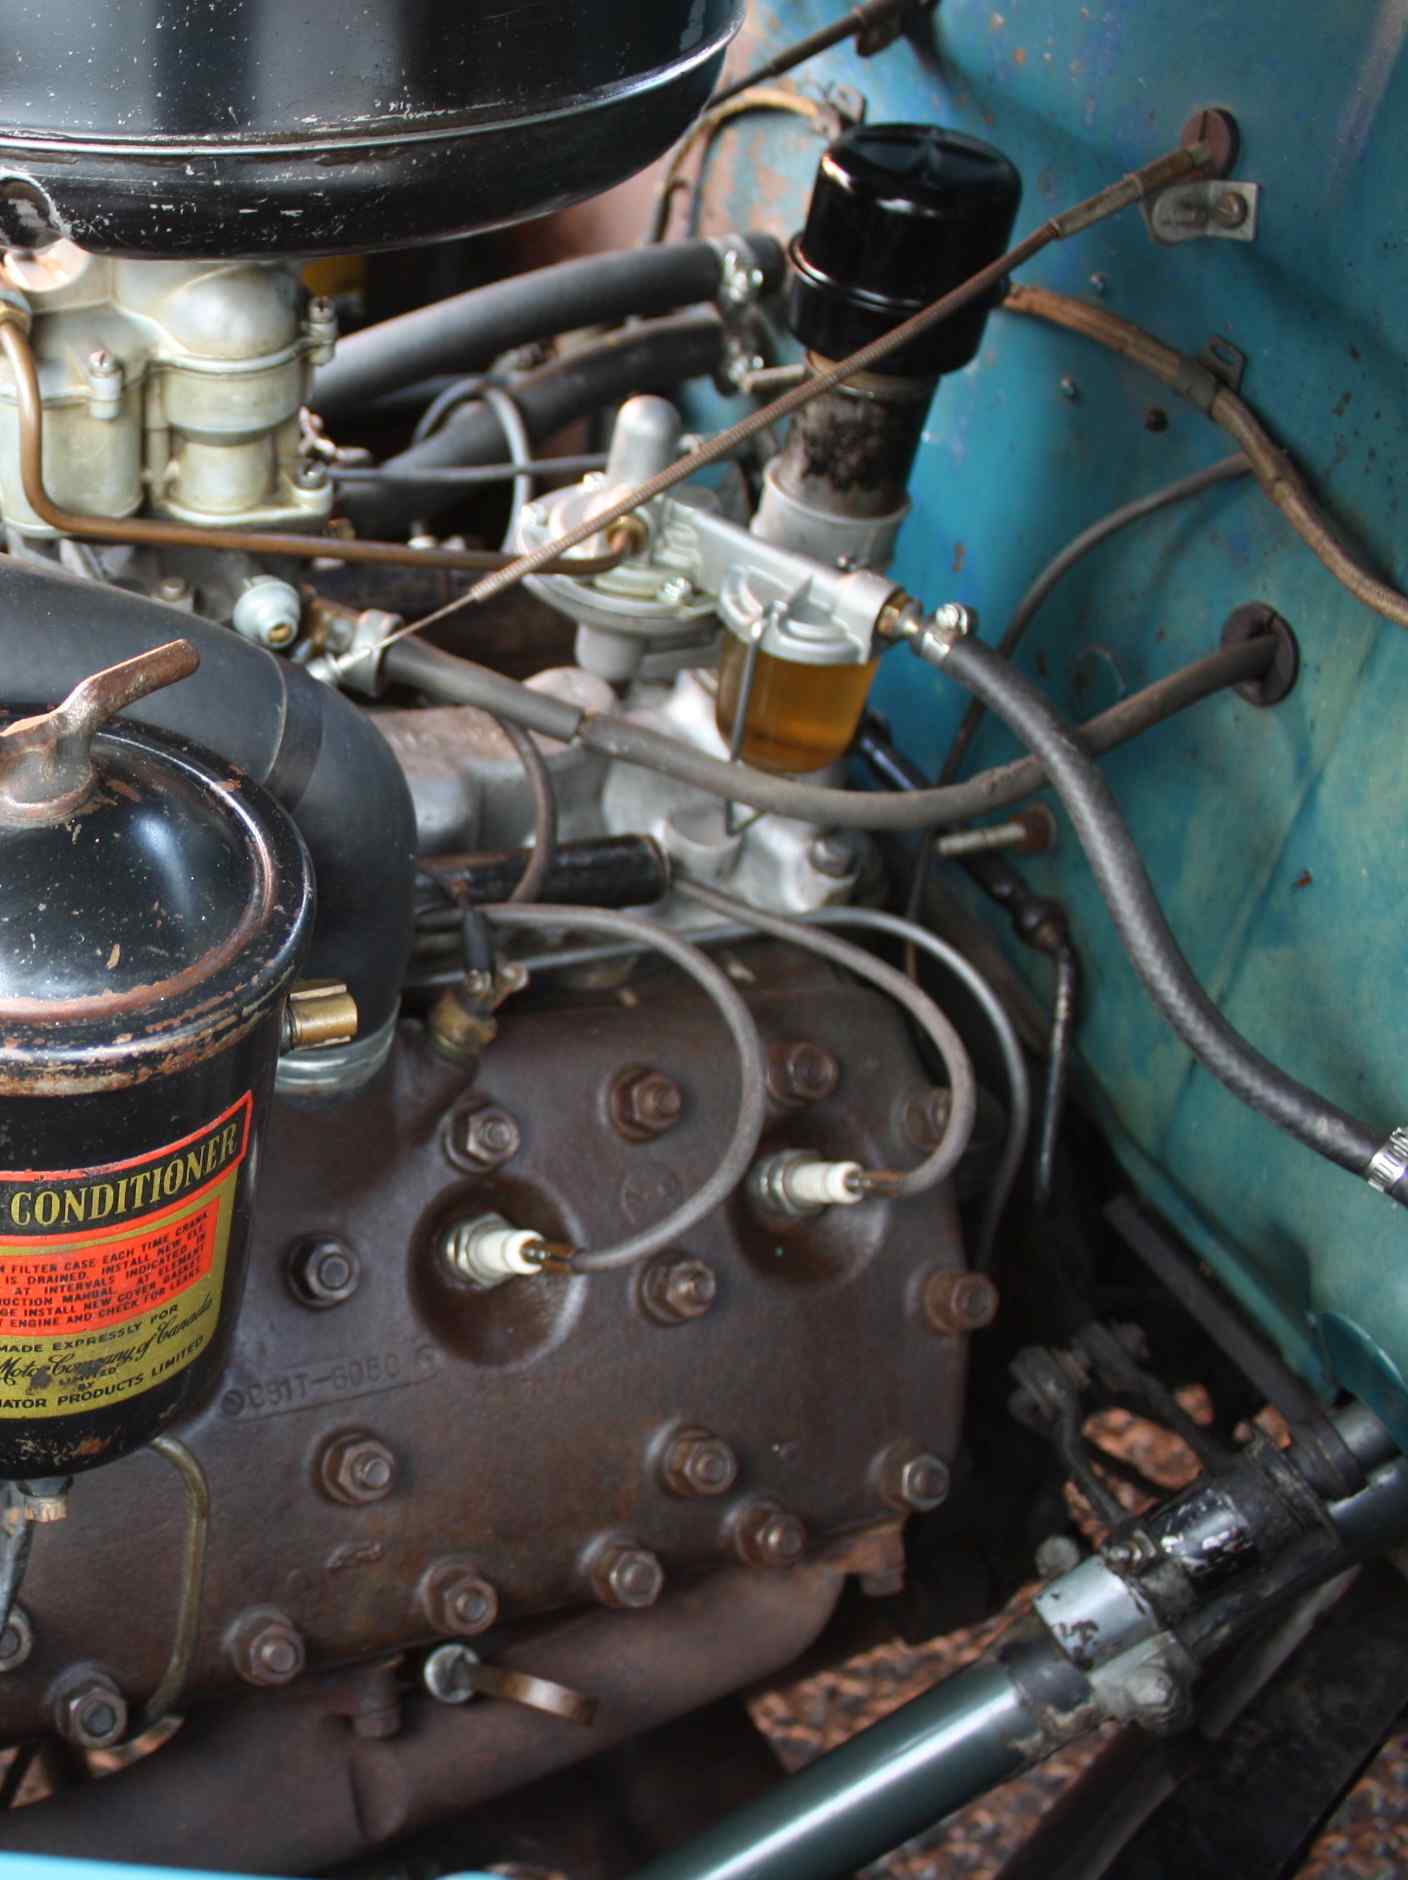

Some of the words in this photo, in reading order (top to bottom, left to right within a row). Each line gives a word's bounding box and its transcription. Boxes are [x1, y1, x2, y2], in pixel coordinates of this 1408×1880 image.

[10, 1123, 238, 1226] CONDITIONER
[5, 1275, 18, 1285] IS
[101, 1254, 150, 1276] INSTALL
[157, 1238, 181, 1257] NEW
[11, 1264, 58, 1275] FILTER
[64, 1258, 96, 1271] CASE
[102, 1247, 135, 1265] EACH
[141, 1233, 169, 1253] TIME
[14, 1286, 32, 1296] AT
[44, 1275, 115, 1295] INTERVALS
[125, 1244, 188, 1280] INDICATED
[9, 1318, 61, 1329] ENGINE
[66, 1312, 93, 1325] AND
[98, 1300, 140, 1318] CHECK
[143, 1286, 167, 1305] FOR
[24, 1304, 77, 1317] INSTALL
[83, 1297, 112, 1311] NEW
[118, 1281, 156, 1303] COVER
[52, 1321, 144, 1352] EXPRESSLY
[150, 1303, 179, 1326] FOR
[57, 1372, 146, 1407] PRODUCTS
[151, 1334, 205, 1378] LIMITED
